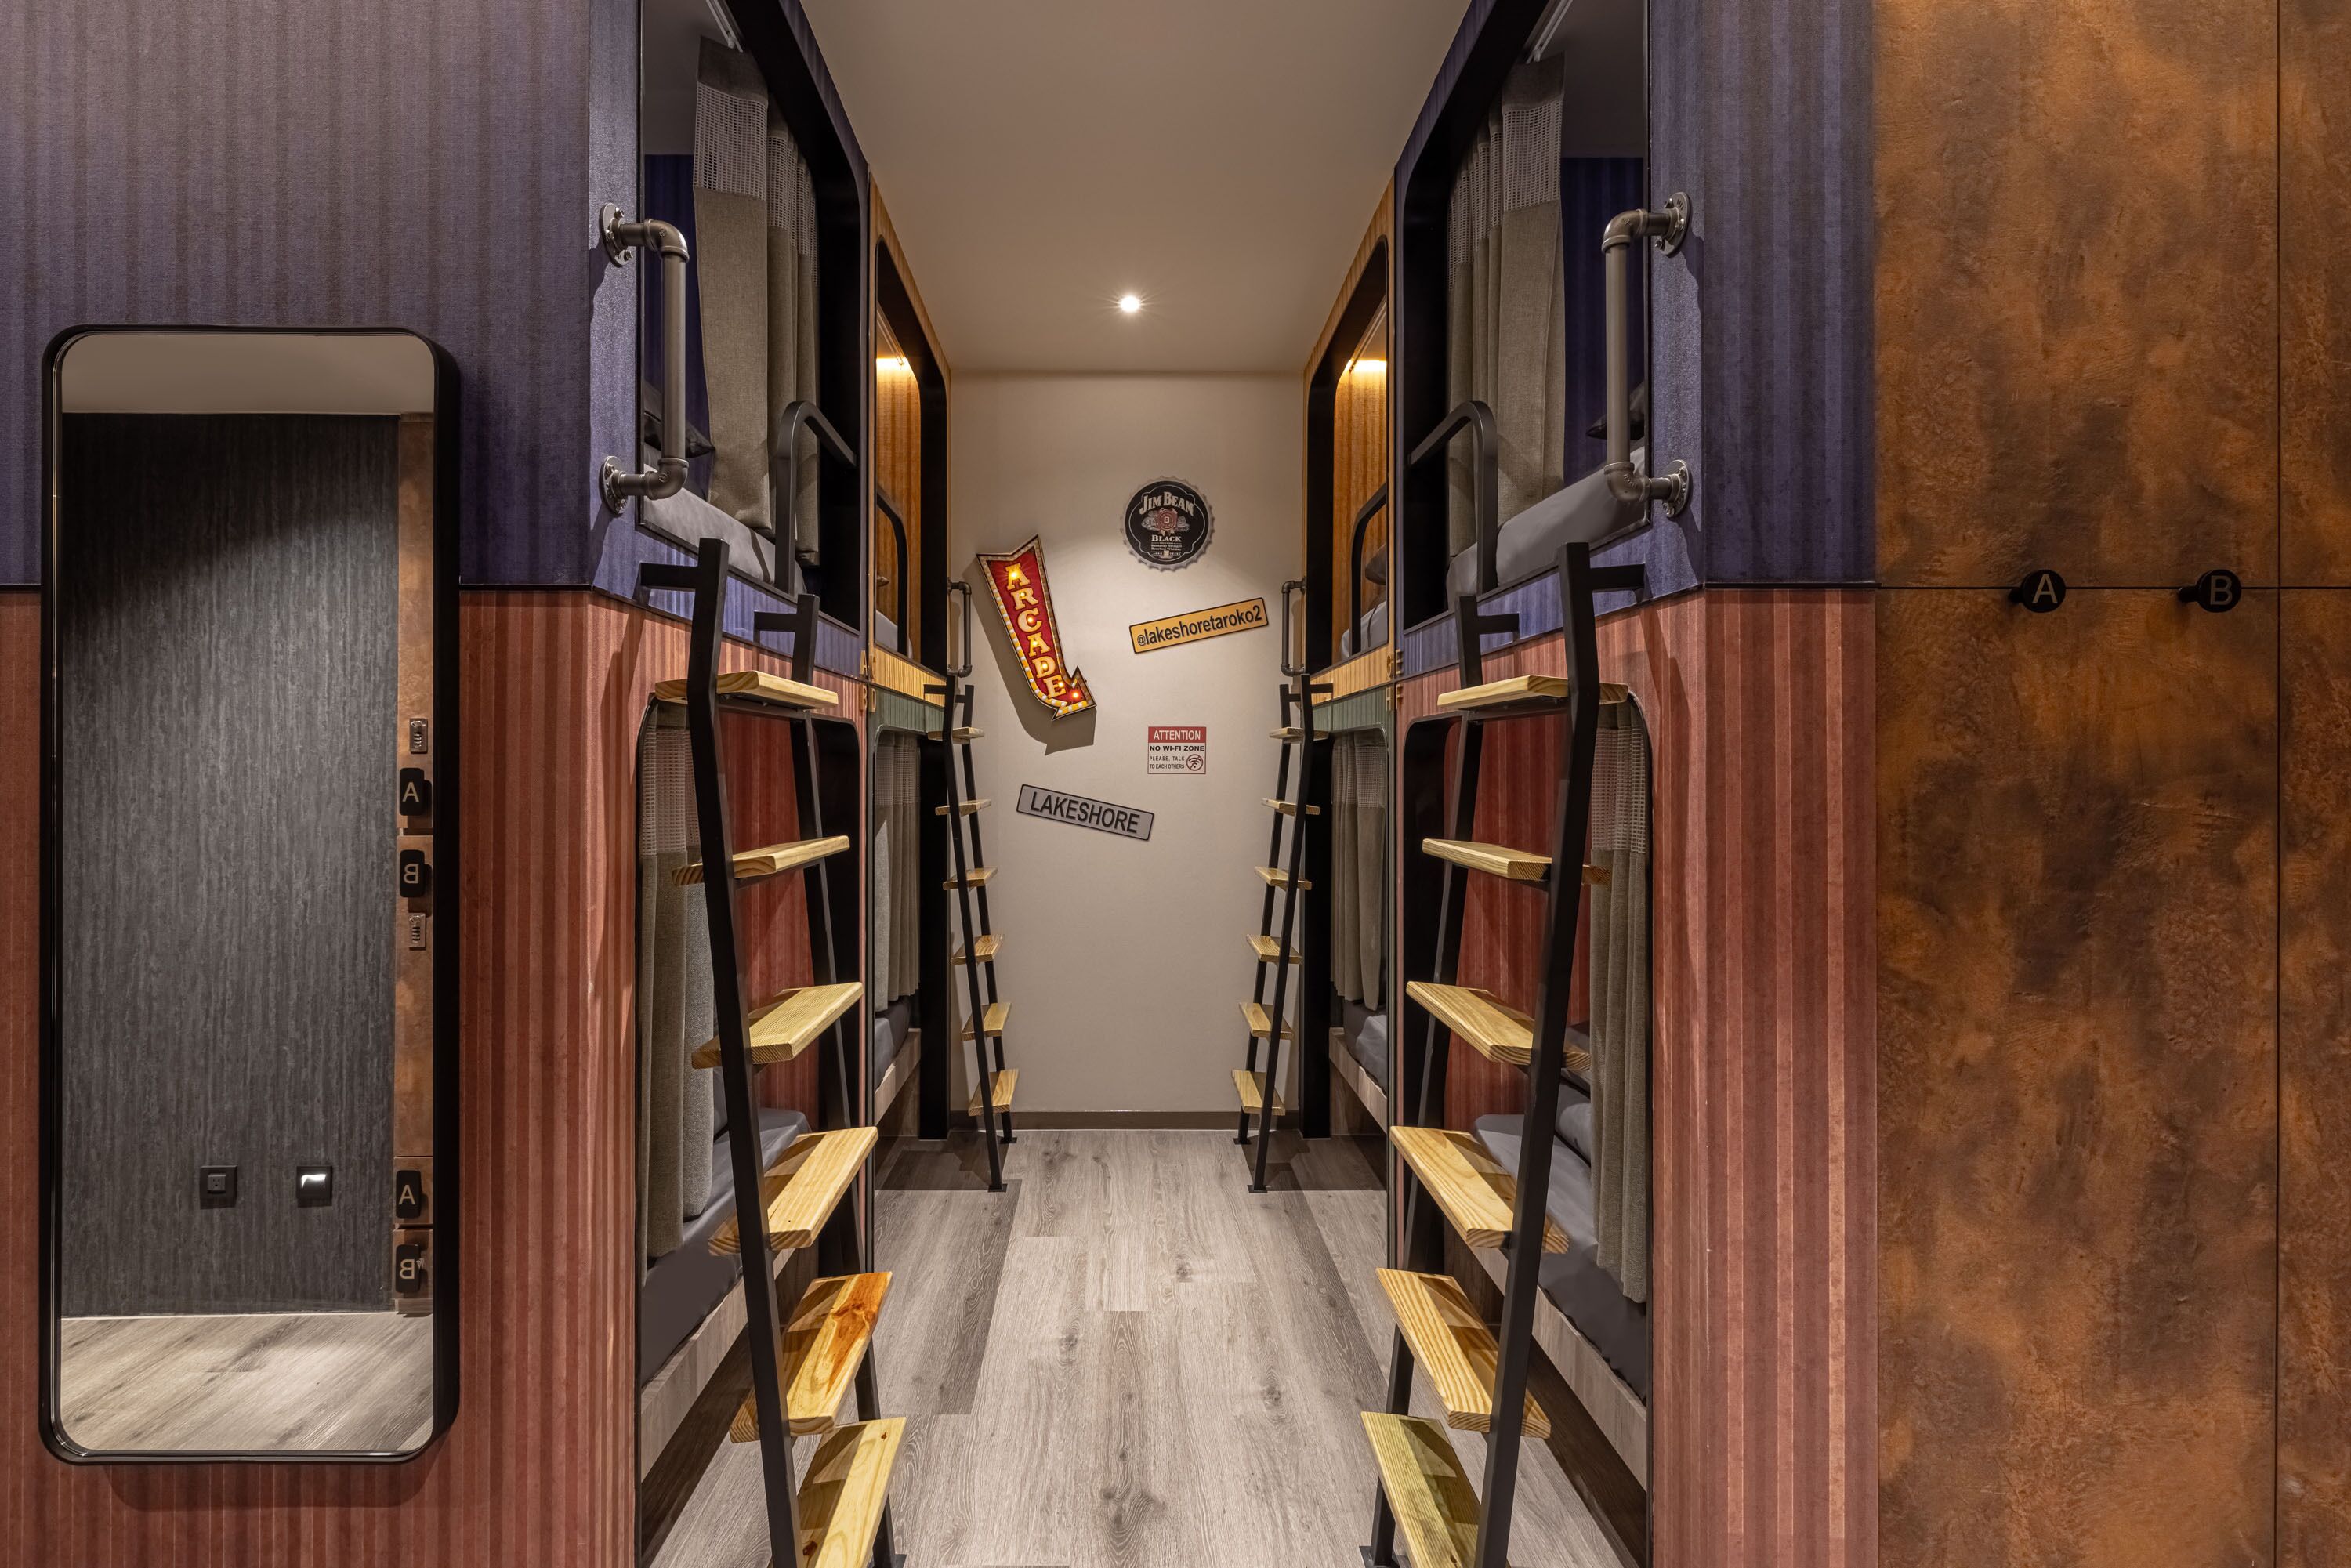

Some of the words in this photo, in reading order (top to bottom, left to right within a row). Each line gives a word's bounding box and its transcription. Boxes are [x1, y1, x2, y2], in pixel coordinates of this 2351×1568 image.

[1139, 495, 1162, 514] JIM
[1163, 491, 1194, 516] BEAM
[2032, 574, 2058, 603] A
[2210, 575, 2233, 605] B
[1005, 563, 1067, 699] ARCADE
[1136, 604, 1262, 646] @lakeshoretaroko2
[1154, 730, 1201, 740] ATTENTION
[1030, 791, 1140, 834] LAKESHORE
